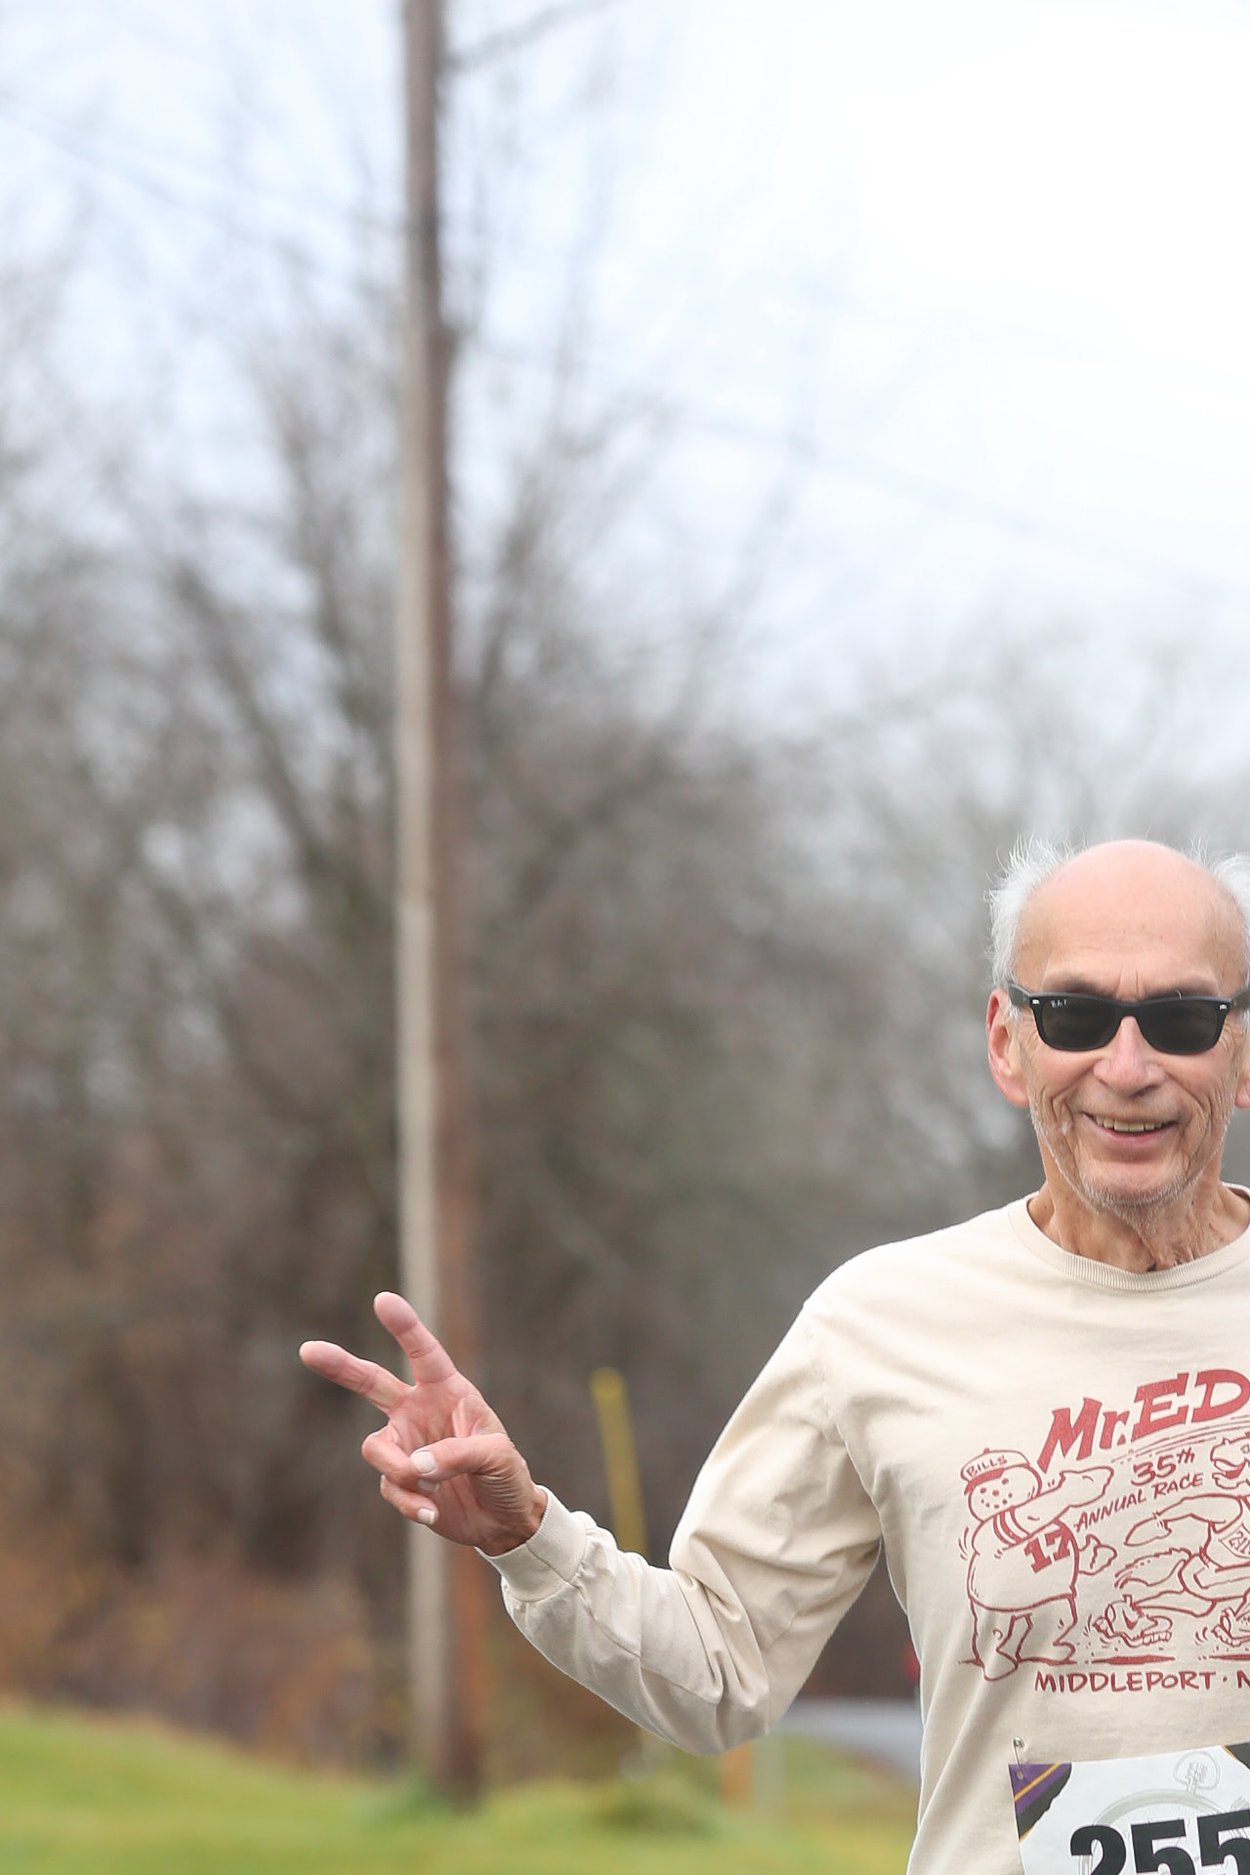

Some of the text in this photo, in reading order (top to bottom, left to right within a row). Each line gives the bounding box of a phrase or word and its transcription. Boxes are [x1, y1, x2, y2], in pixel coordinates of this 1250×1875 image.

[1131, 1447, 1195, 1486] 35th
[1074, 1472, 1204, 1532] ANNUAL RACE
[1024, 1528, 1071, 1574] 17
[1034, 1670, 1217, 1693] MIDDLEPORT
